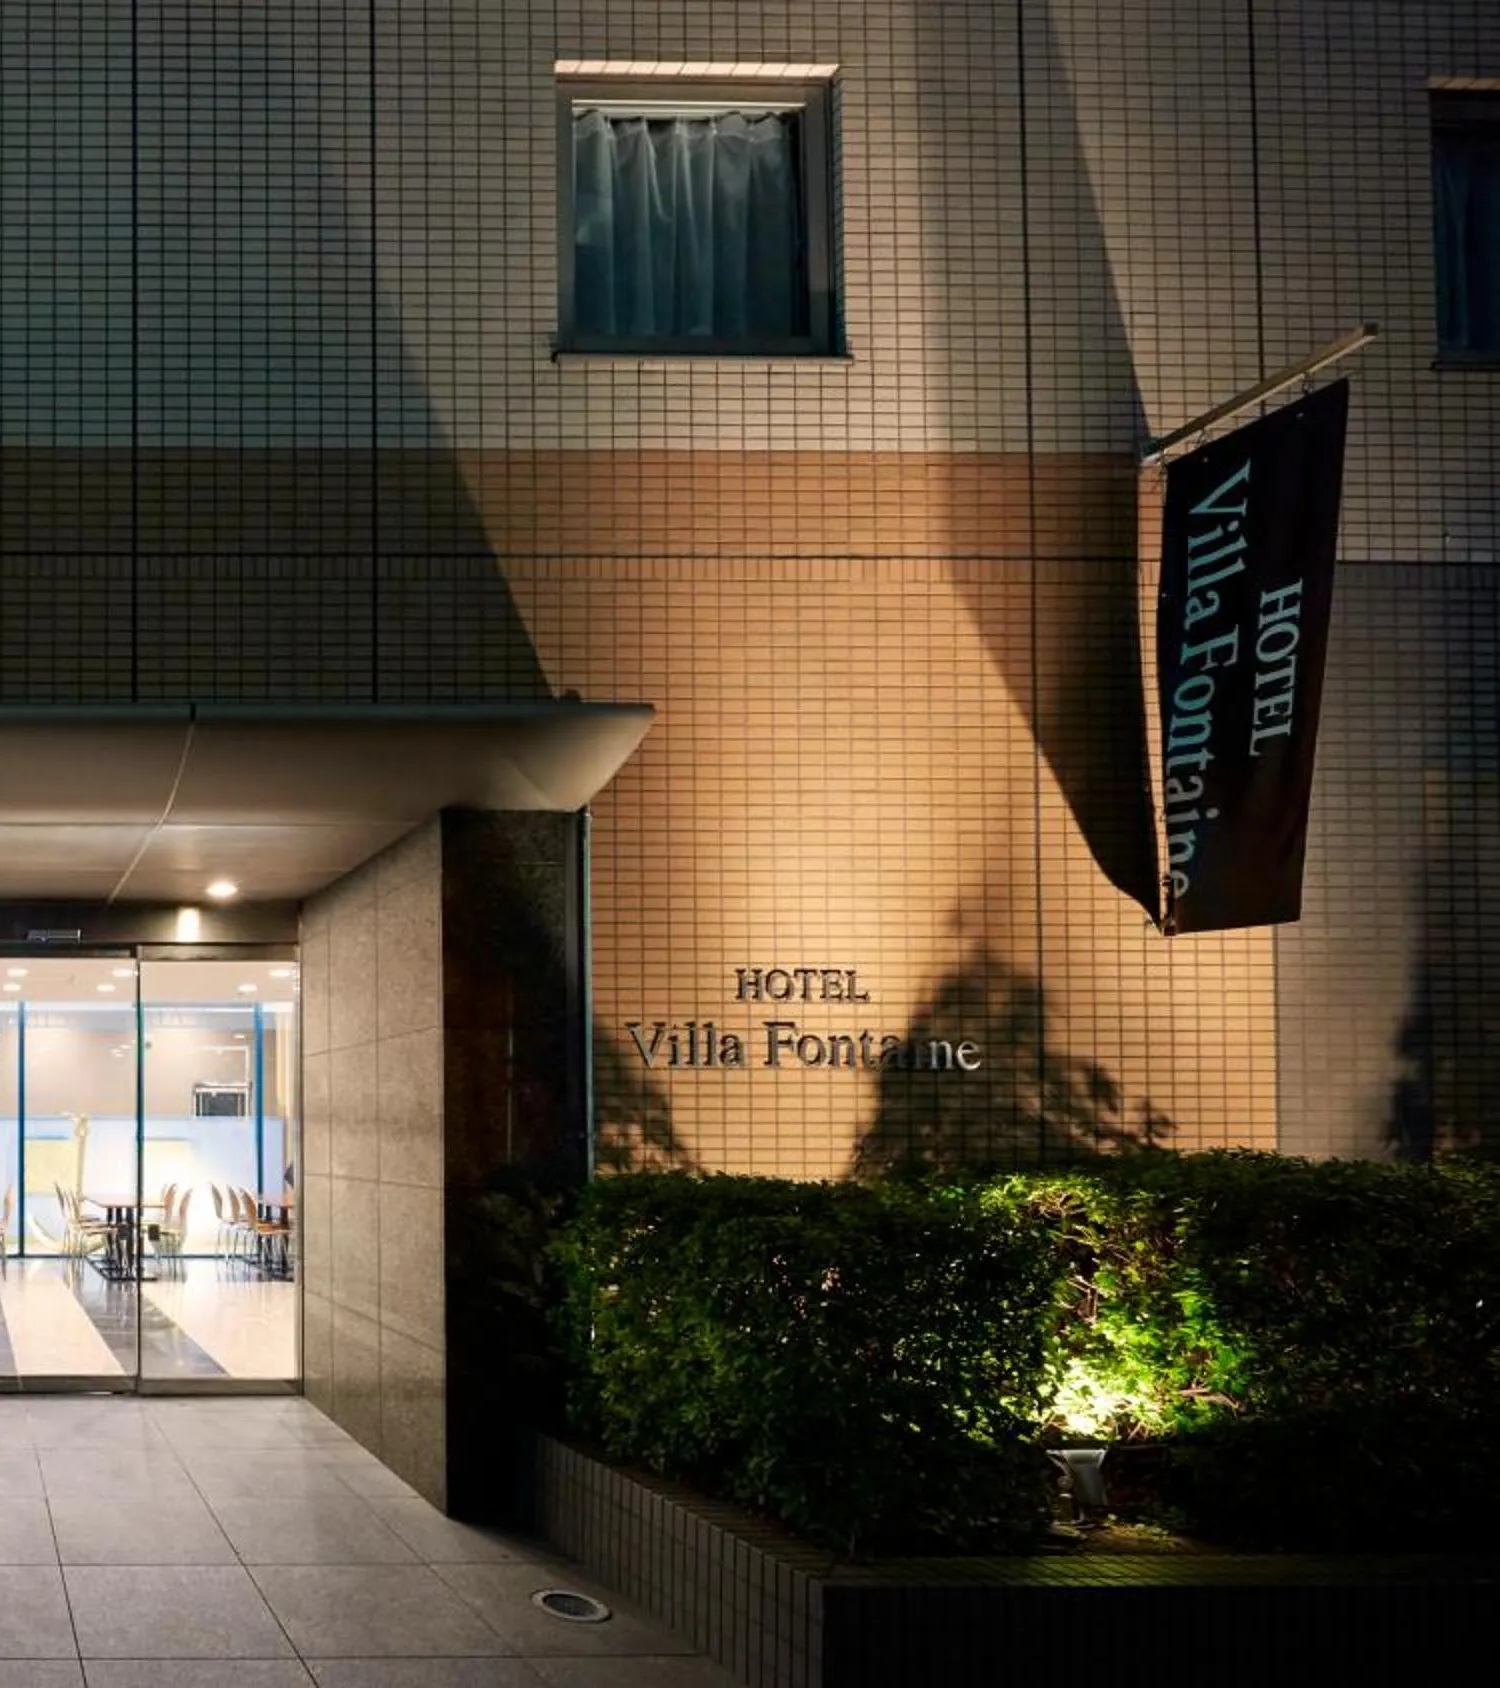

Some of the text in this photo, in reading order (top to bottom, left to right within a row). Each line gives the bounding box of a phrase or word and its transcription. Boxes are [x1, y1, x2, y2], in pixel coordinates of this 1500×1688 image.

[1184, 459, 1251, 629] Villa
[1248, 579, 1303, 756] HOTEL
[736, 968, 870, 1003] HOTEL
[625, 1021, 747, 1069] Villa
